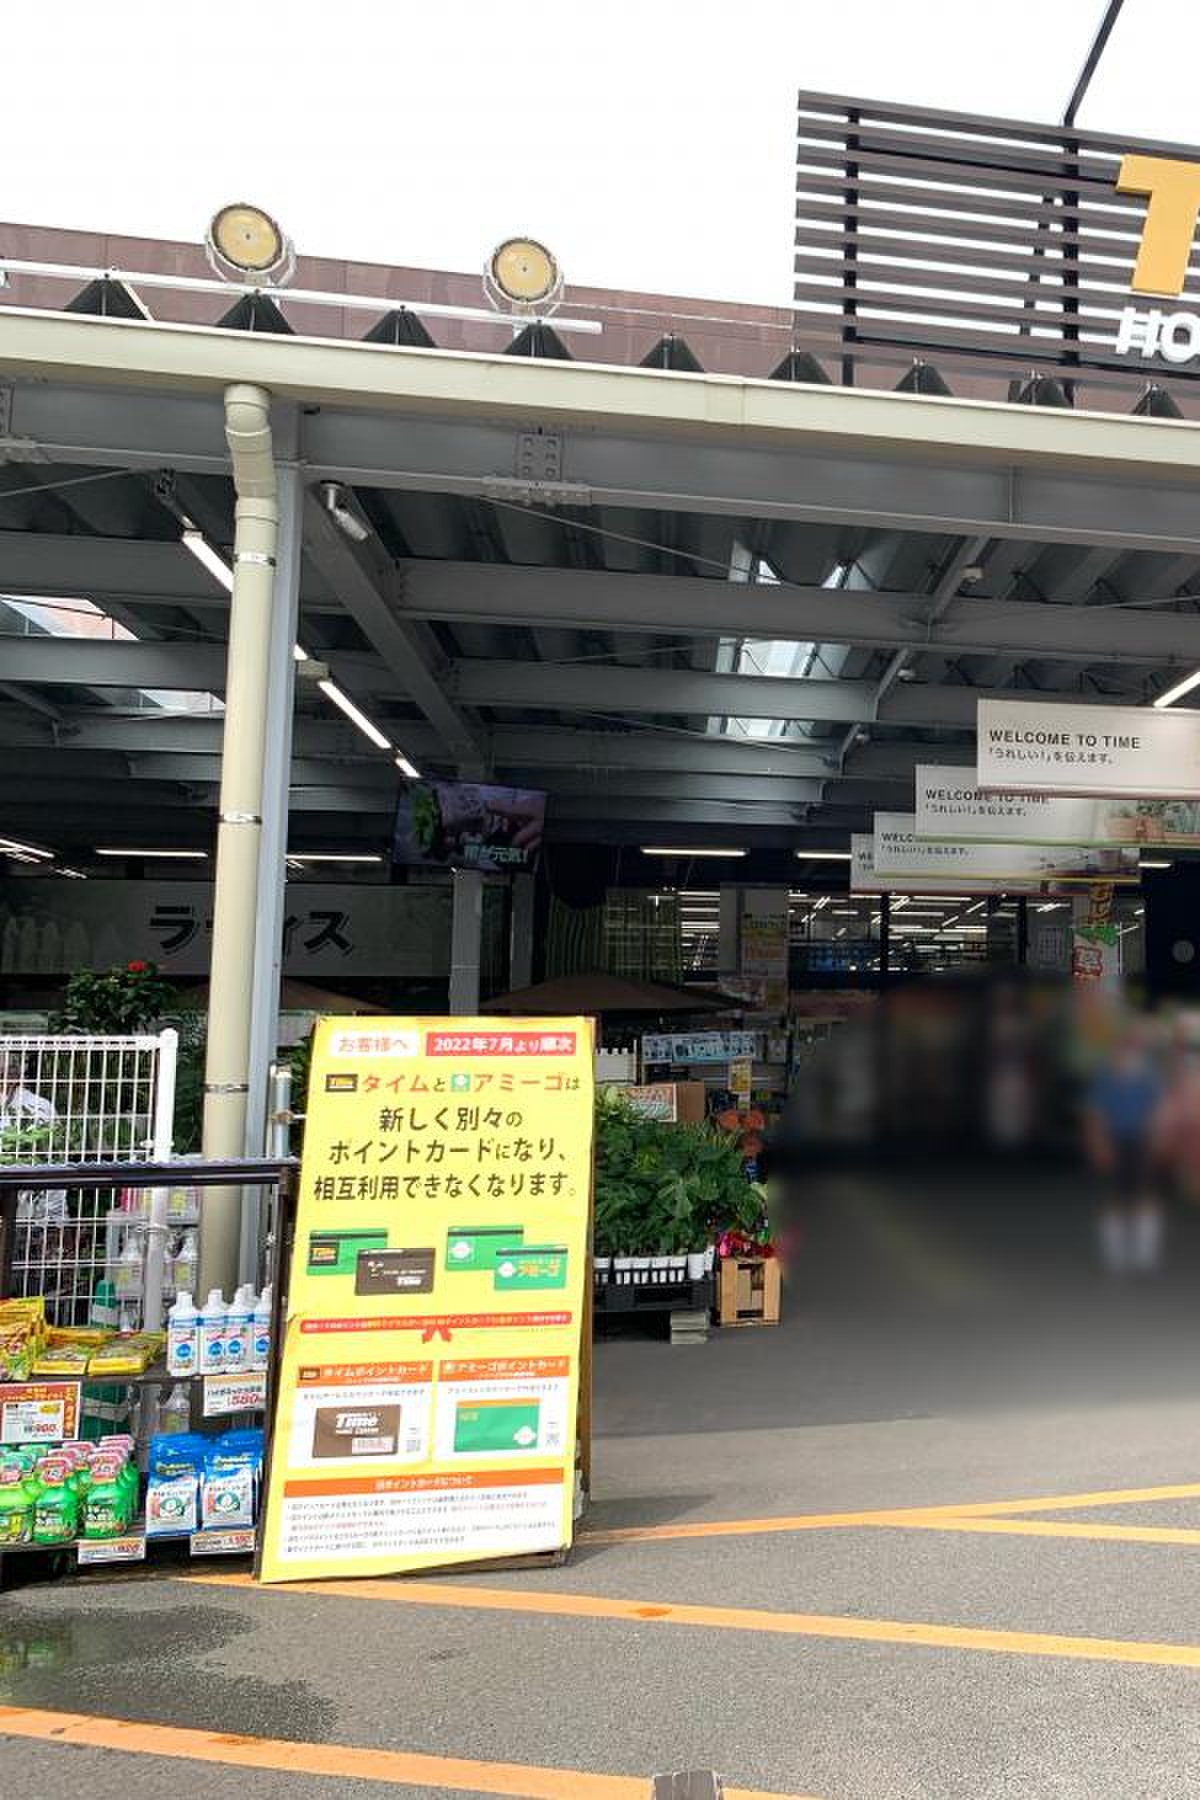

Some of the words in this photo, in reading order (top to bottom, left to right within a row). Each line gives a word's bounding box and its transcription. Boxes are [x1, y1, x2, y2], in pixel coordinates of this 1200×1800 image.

[989, 729, 1071, 746] WELCOME
[1077, 734, 1097, 748] TO
[1102, 735, 1141, 749] TIME
[338, 1035, 410, 1052] お客様へ
[378, 1106, 523, 1133] 新しく別々の
[328, 1138, 567, 1165] ポイントカードになり、
[314, 1171, 576, 1201] 相互利用できなくなります。
